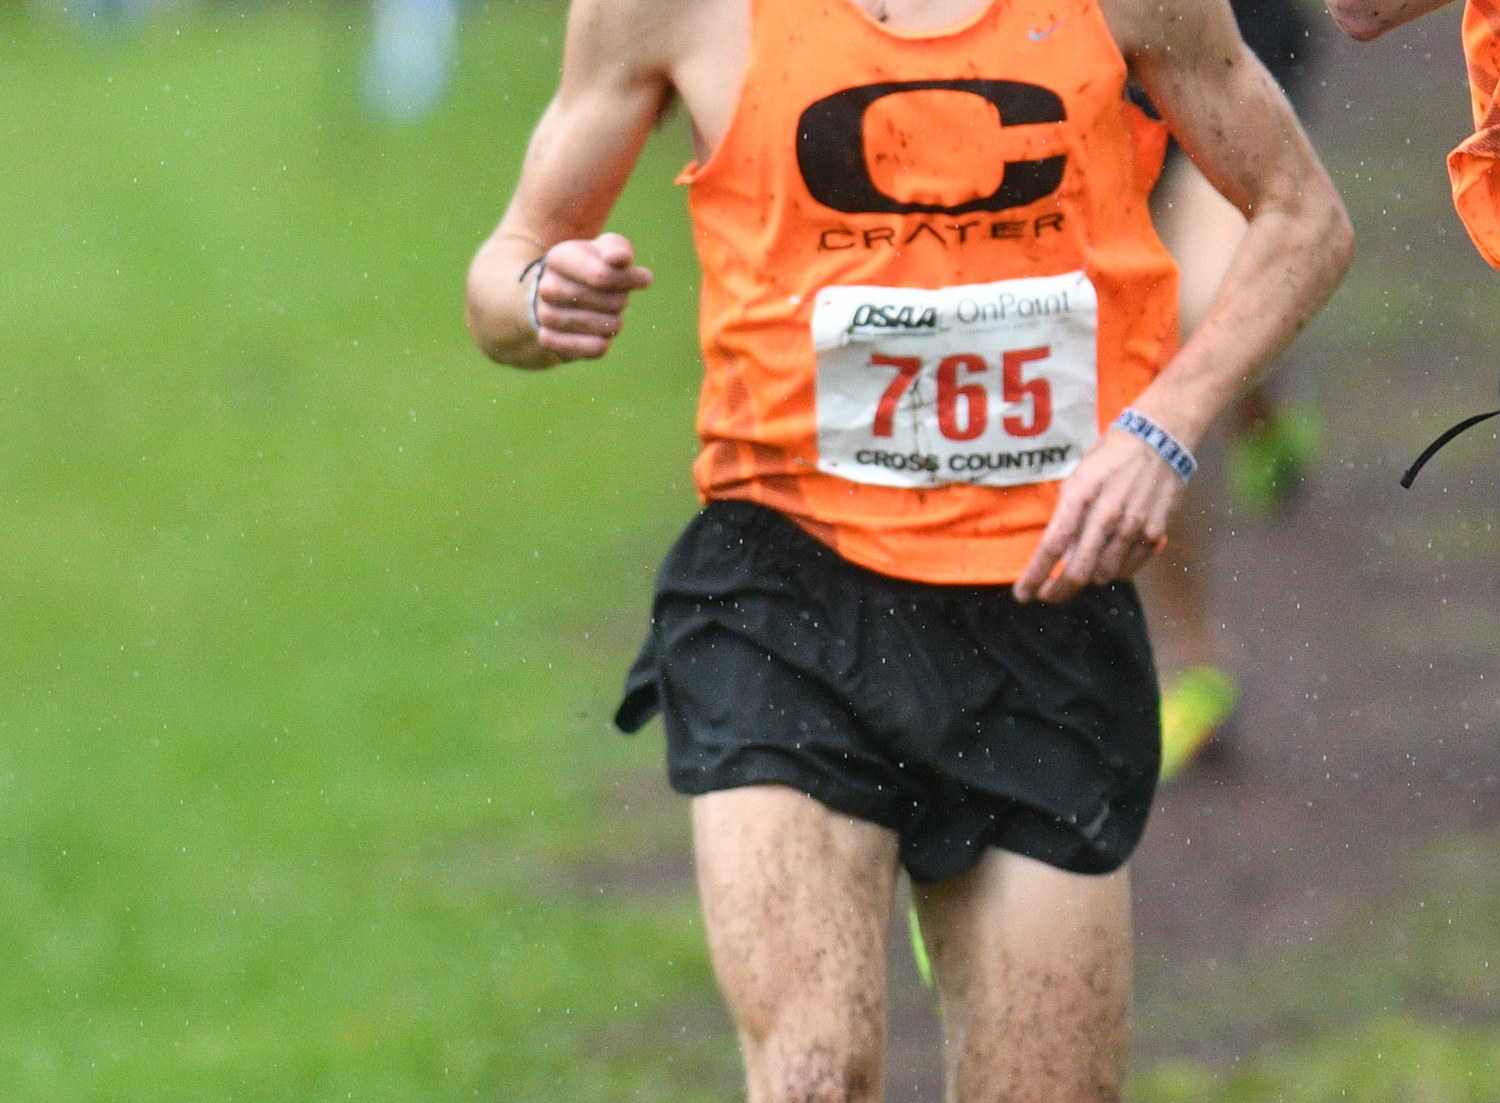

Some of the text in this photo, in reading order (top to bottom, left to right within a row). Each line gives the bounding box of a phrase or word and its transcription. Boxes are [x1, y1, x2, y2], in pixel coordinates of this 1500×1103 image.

[796, 79, 1067, 215] C
[819, 213, 1066, 252] CRATER
[852, 303, 937, 328] OSAA
[957, 291, 1070, 323] OnPoint
[871, 346, 1052, 441] 765
[856, 444, 1071, 473] CROSS COUNTRY
